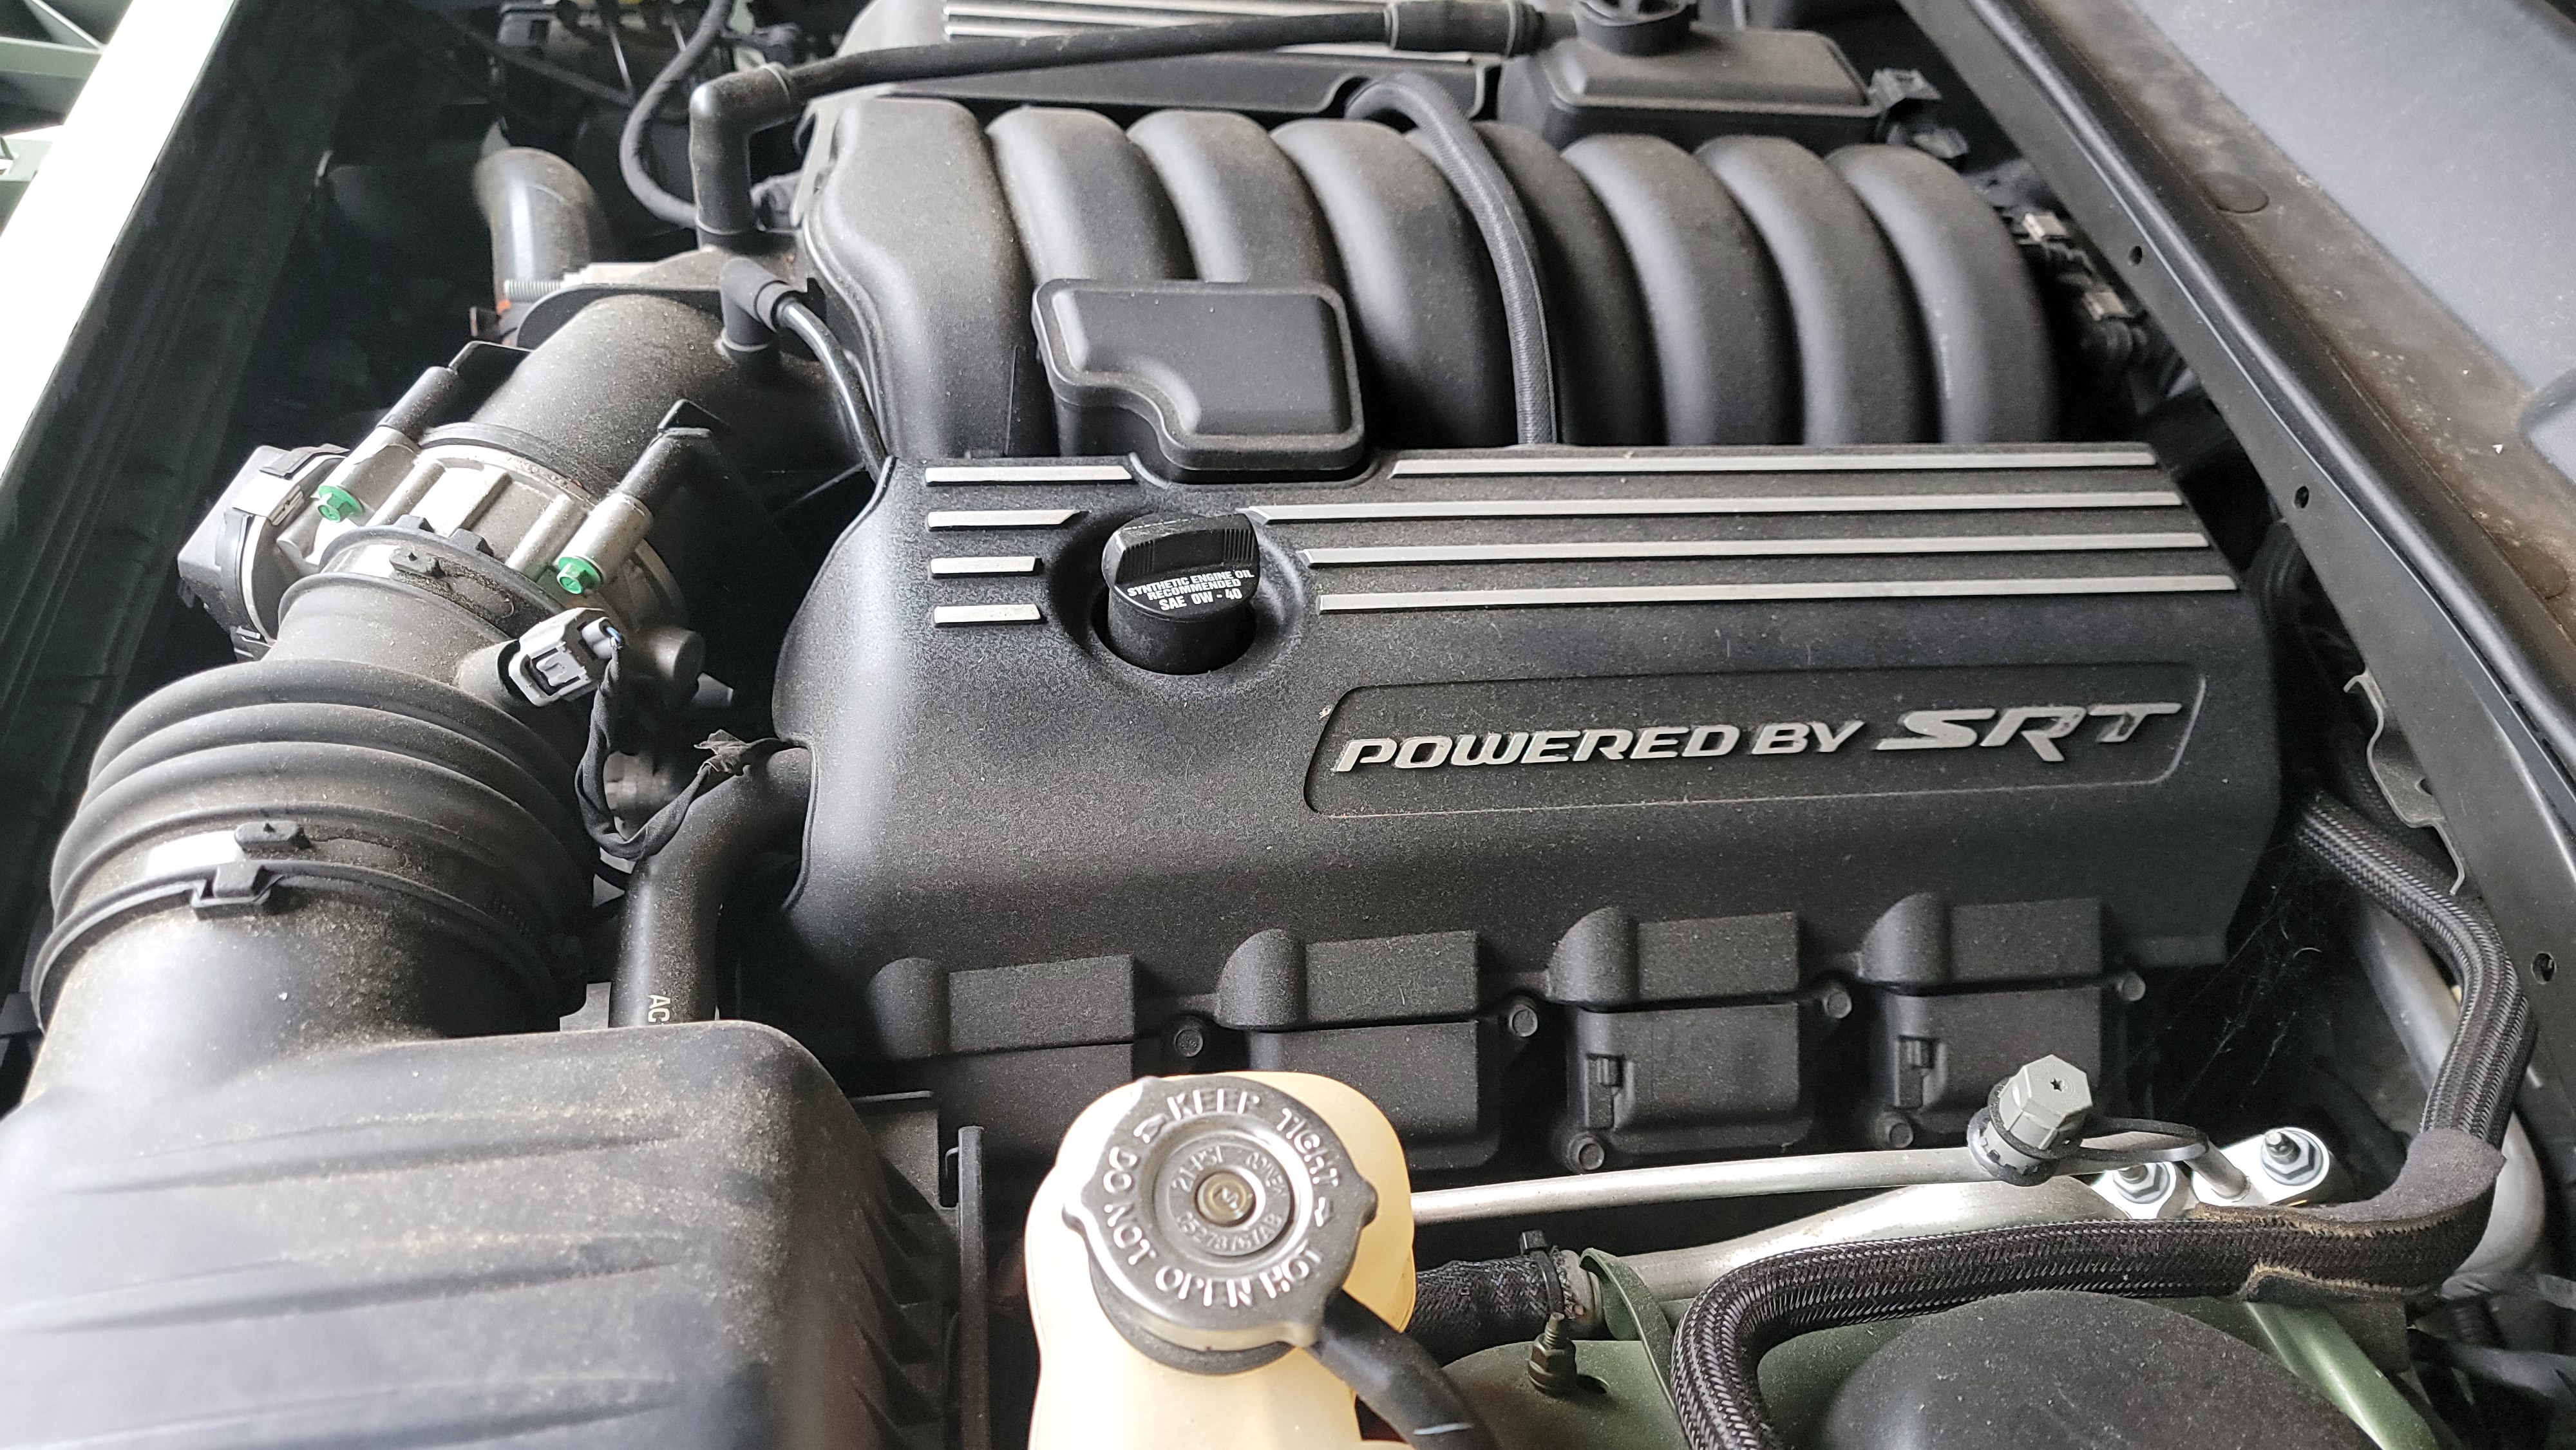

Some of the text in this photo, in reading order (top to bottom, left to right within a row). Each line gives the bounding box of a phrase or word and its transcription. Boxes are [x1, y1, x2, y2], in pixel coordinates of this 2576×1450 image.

[1127, 569, 1255, 597] SYNTHETIC ENGINE OIL
[1147, 579, 1242, 601] RECOMMENDED
[1159, 596, 1188, 611] SAE
[1191, 591, 1214, 605] 0W
[1225, 588, 1243, 600] 40
[1335, 702, 2183, 773] POWERED BY SRT
[1166, 1088, 1340, 1187] KEEP TIGHT
[1103, 1146, 1322, 1308] DO NOT OPEN HOT
